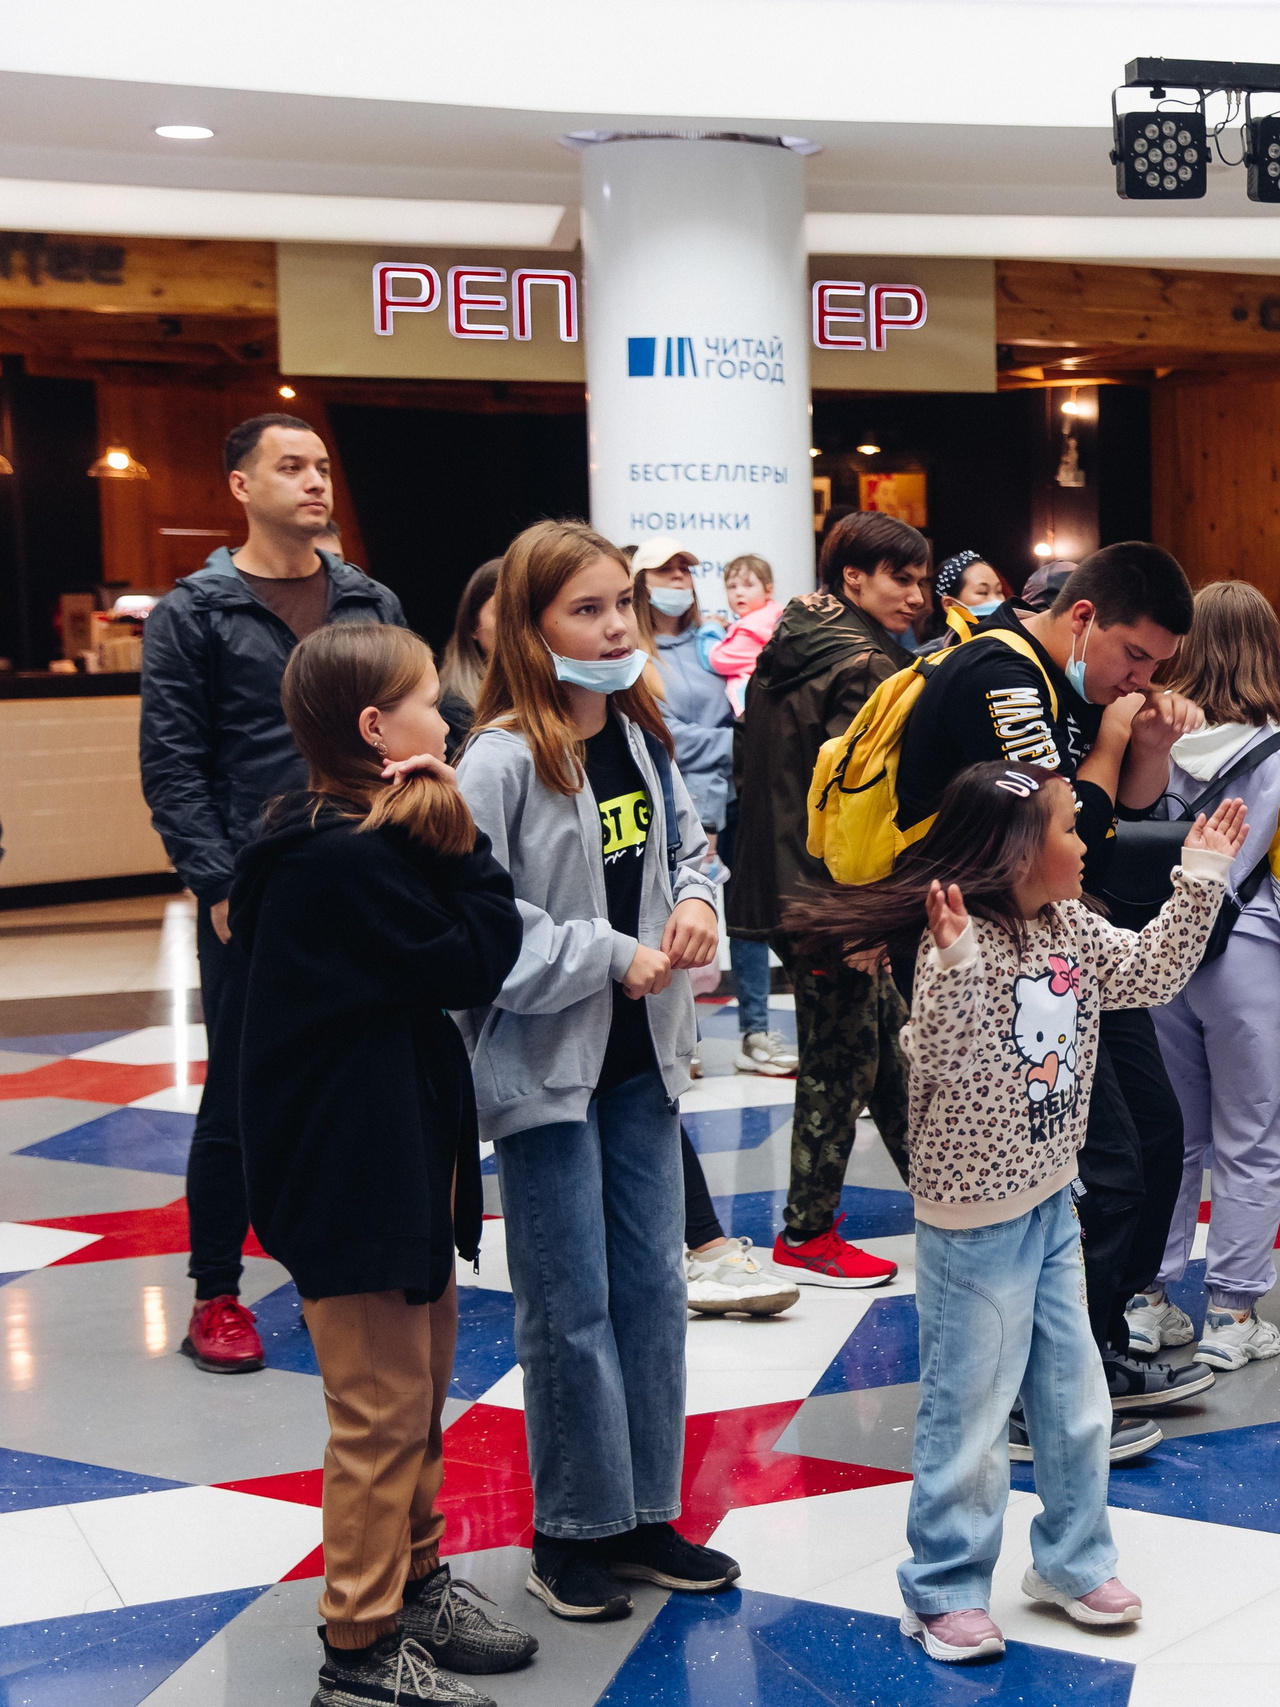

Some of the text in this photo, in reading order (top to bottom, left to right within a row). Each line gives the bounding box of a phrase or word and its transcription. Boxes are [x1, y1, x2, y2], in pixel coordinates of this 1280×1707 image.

[705, 336, 784, 360] ЧИТАЙ
[706, 359, 786, 385] ГОРОД
[630, 463, 789, 484] БЕСТСЕЛЛЕРЫ
[631, 512, 751, 530] НОВИНКИ
